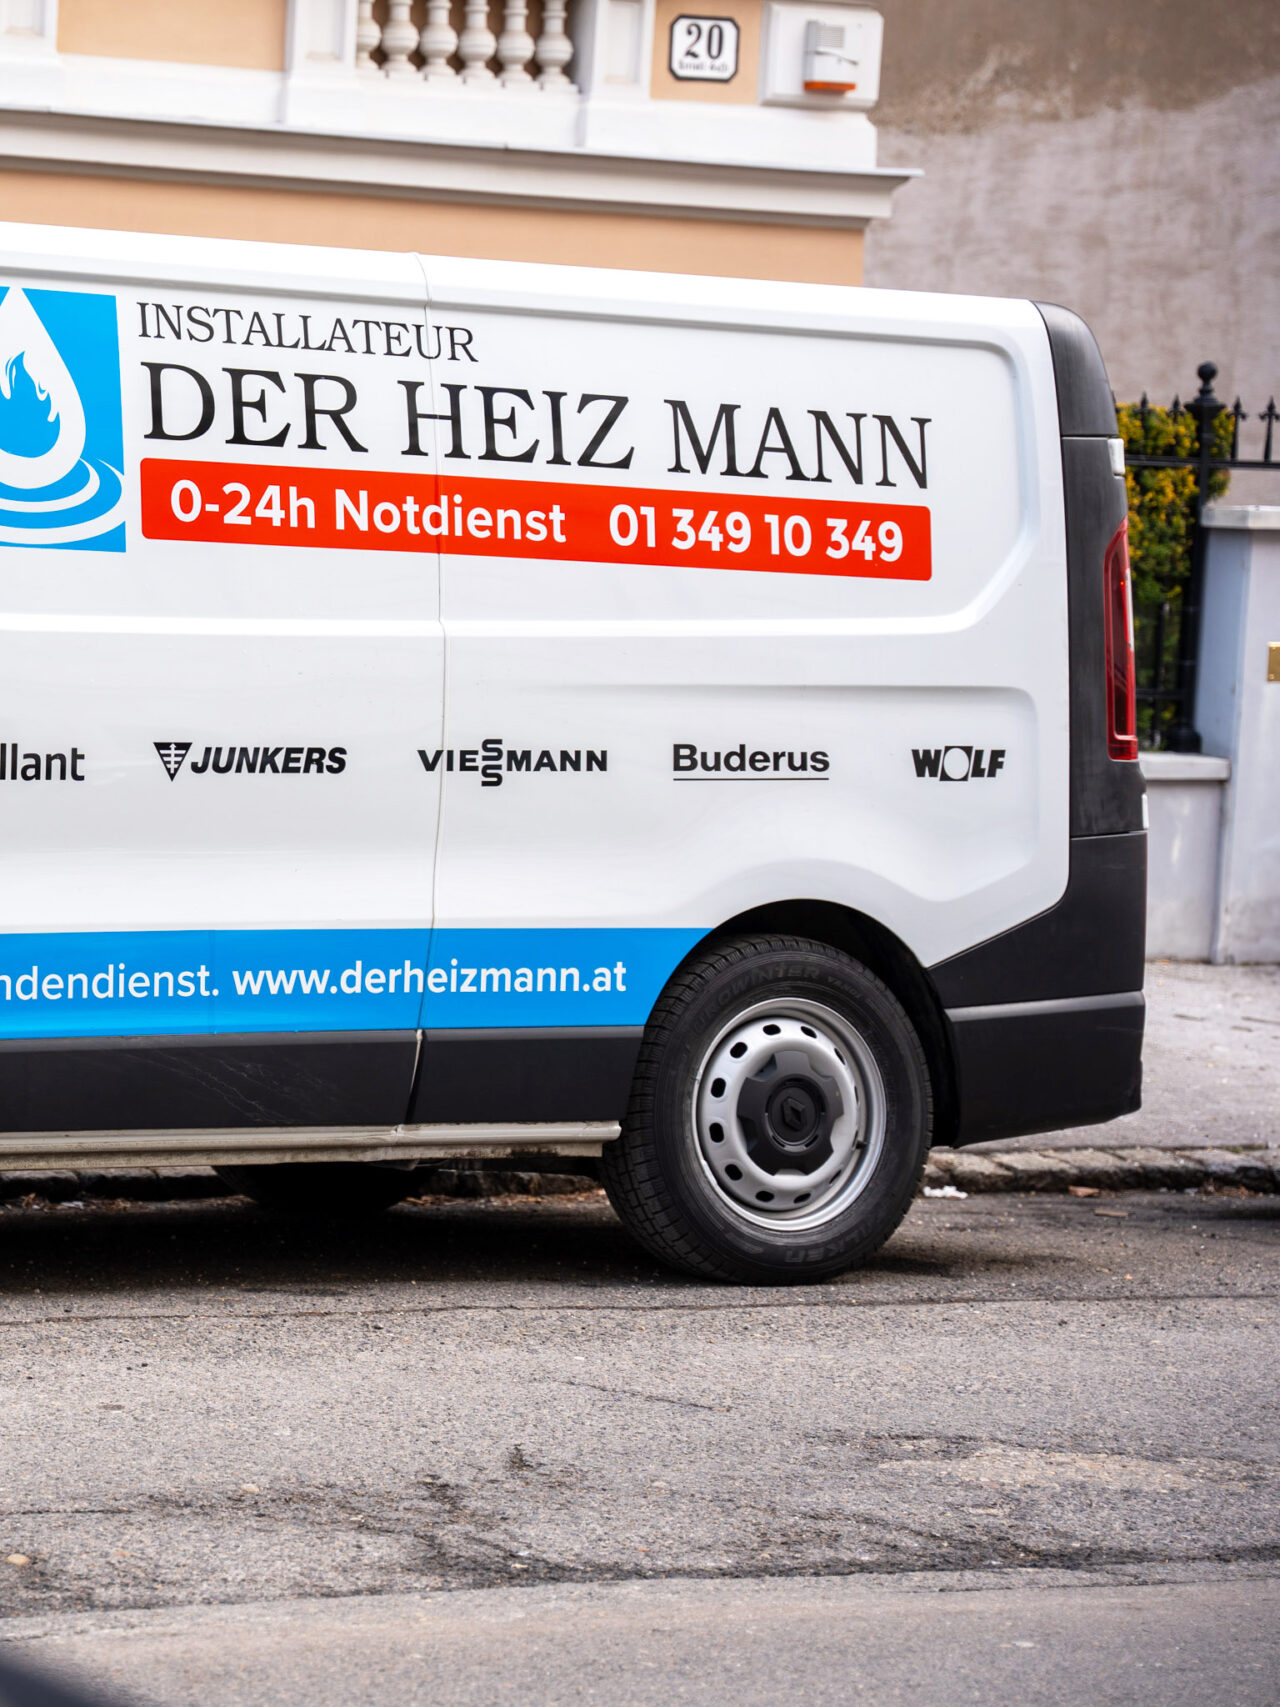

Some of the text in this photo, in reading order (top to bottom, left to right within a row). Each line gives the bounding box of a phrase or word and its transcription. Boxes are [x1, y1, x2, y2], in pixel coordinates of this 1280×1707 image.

[684, 23, 724, 60] 20
[137, 302, 478, 362] INSTALLATEUR
[140, 361, 932, 488] DER HEIZ MANN
[170, 479, 905, 563] 0-24h Notdienst 01 349 10 349
[190, 746, 348, 775] JUNKERS
[417, 738, 608, 787] VIESSMANN
[673, 743, 831, 773] Buderus
[911, 745, 1006, 782] WOLF
[232, 958, 628, 996] www.derheizmann.at
